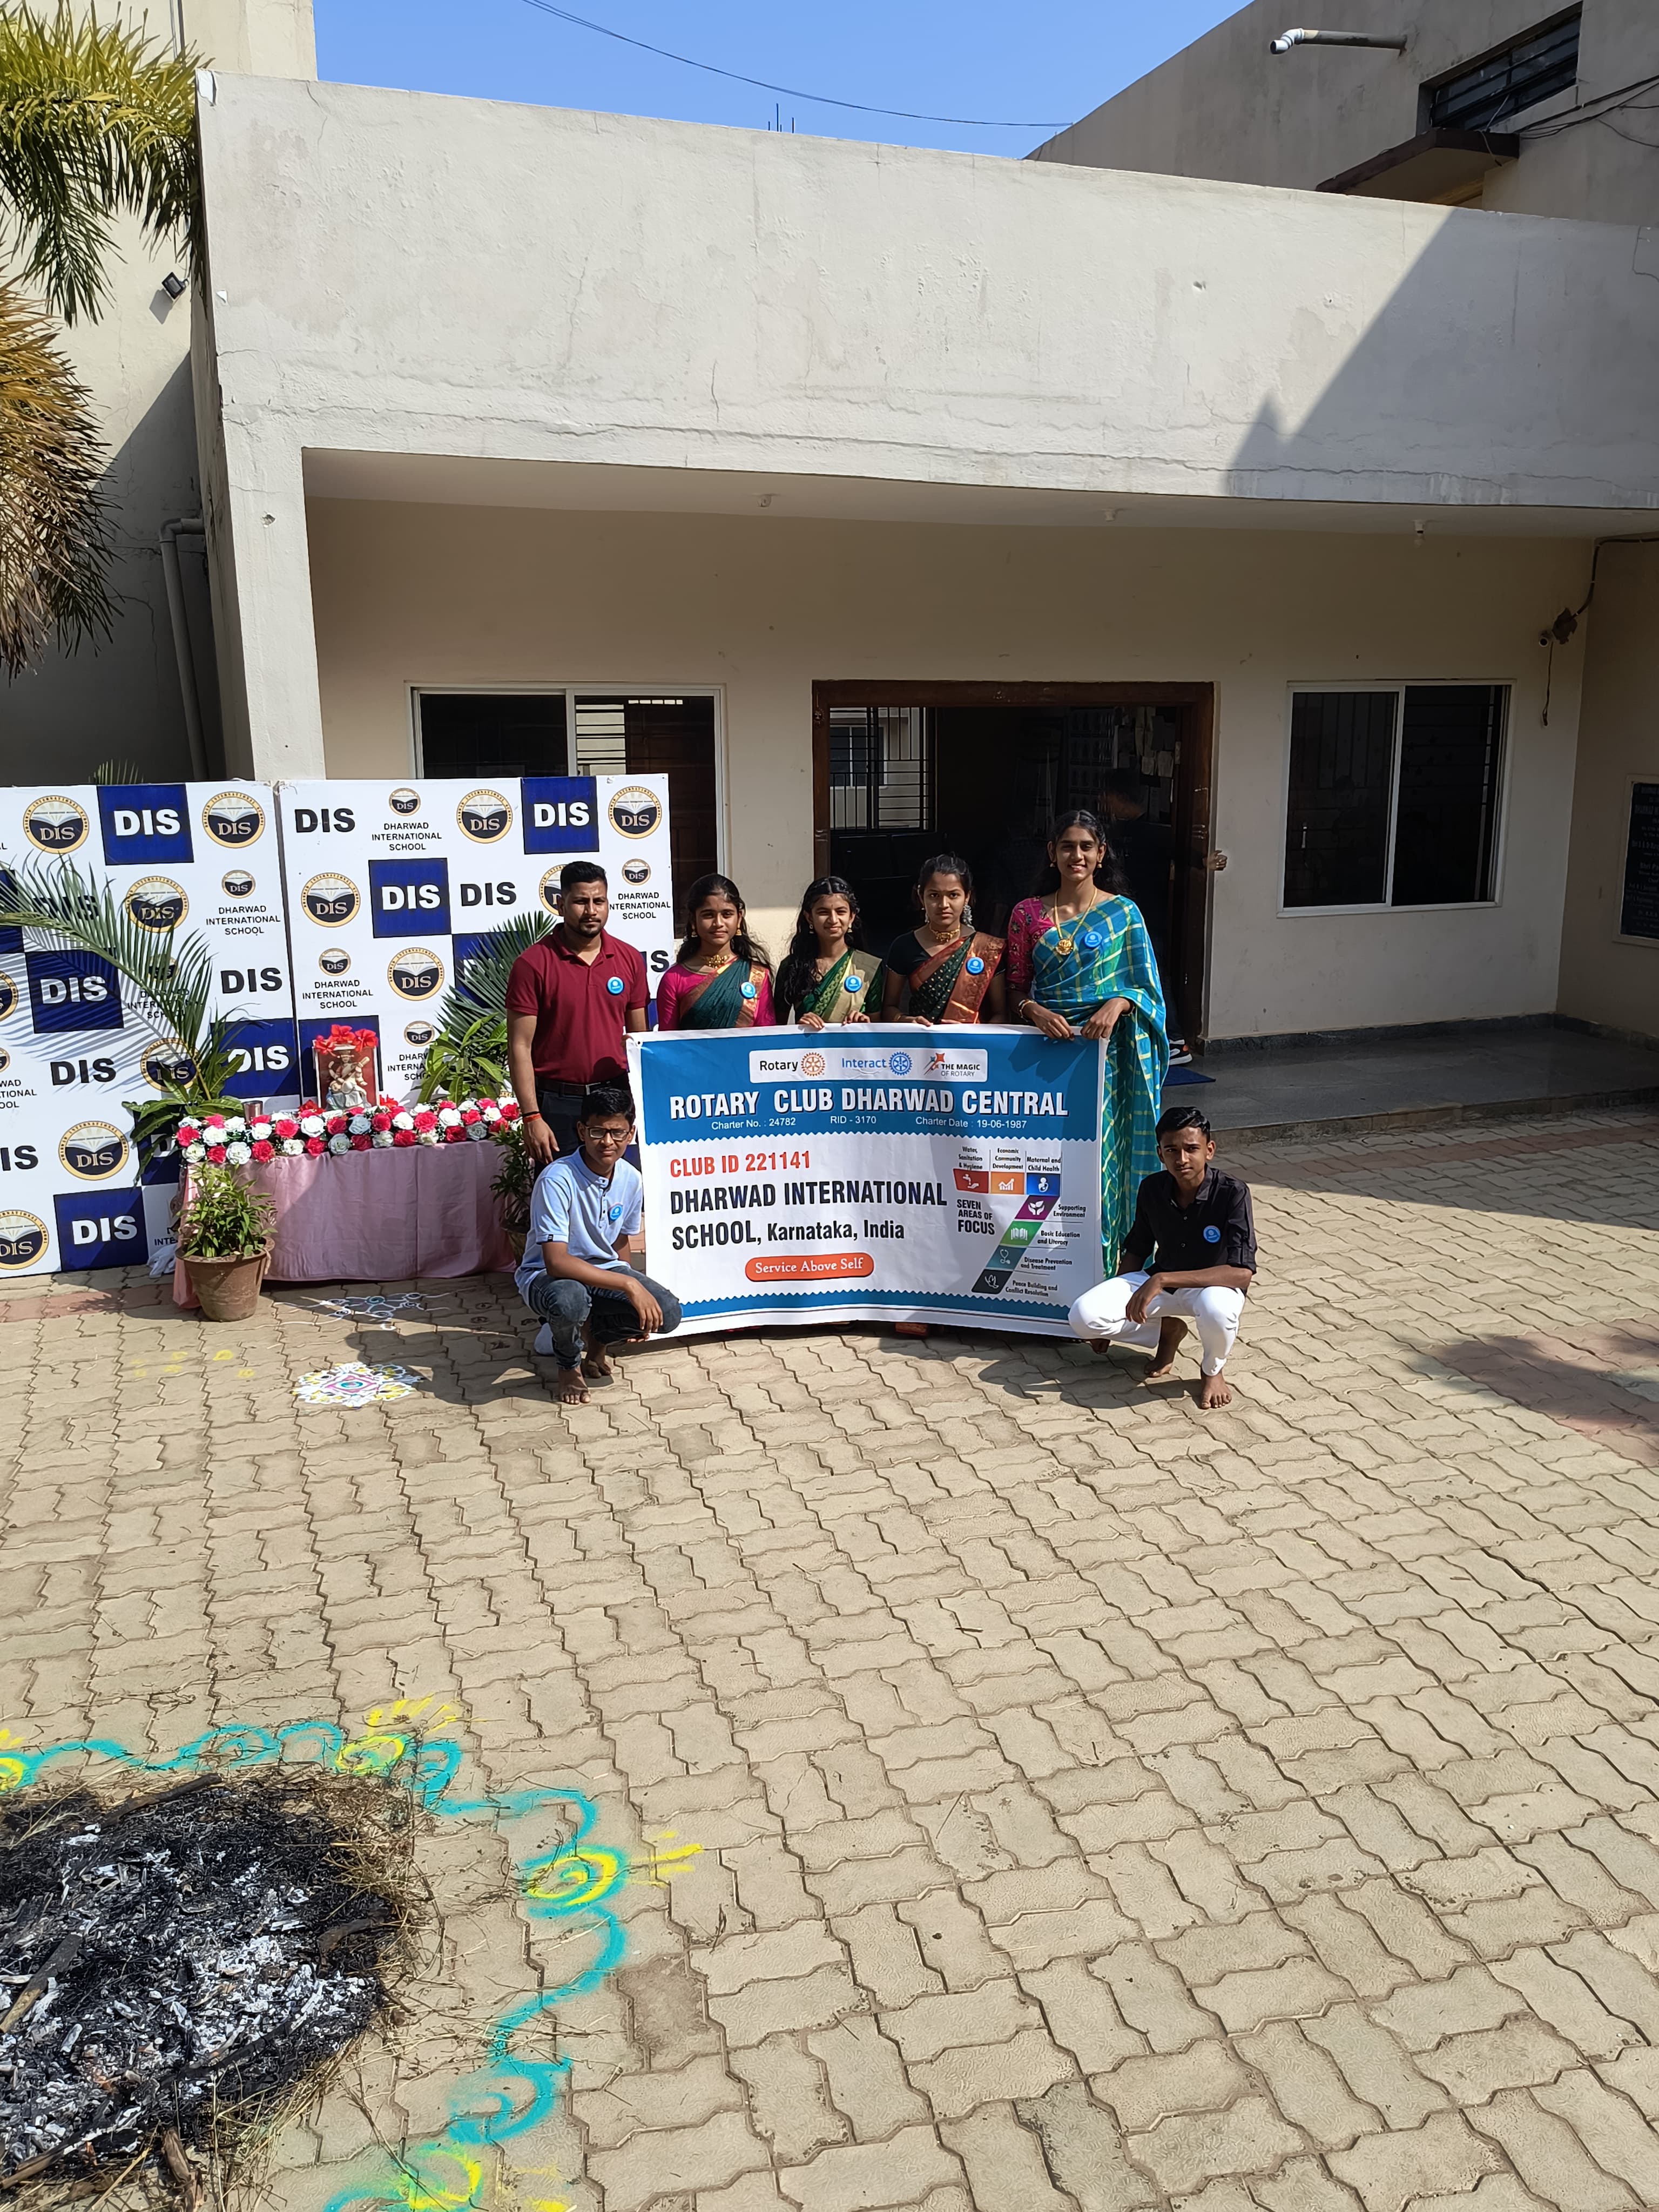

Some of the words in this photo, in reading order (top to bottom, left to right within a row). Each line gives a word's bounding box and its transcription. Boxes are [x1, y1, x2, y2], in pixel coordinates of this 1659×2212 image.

[294, 808, 355, 833] DIS
[534, 802, 590, 827] DIS
[621, 814, 650, 826] DIS
[113, 809, 180, 836] DIS
[218, 822, 251, 835] DIS
[384, 822, 429, 831] DHARWAD
[470, 818, 500, 831] DIS
[40, 827, 75, 840] DIS
[372, 832, 442, 841] INTERNATIONAL
[382, 884, 440, 910] DIS
[460, 882, 516, 906] DIS
[618, 892, 659, 900] DHARWAD
[219, 906, 266, 914] DHARWAD
[315, 902, 347, 915] DIS
[609, 901, 671, 910] NTERNATIONAL
[141, 907, 174, 920] DIS
[206, 915, 281, 925] INTERNATIONAL
[225, 926, 264, 935] SCHOOL
[220, 967, 282, 994] DIS
[314, 980, 360, 989] DHARWAD
[401, 976, 431, 989] DIS
[41, 976, 107, 1004] DIS
[302, 989, 373, 1000] INTERNATIONAL
[320, 1000, 358, 1009] SCHOOL
[388, 1063, 426, 1071] INTERNA
[760, 1060, 798, 1072] Rotary
[842, 1058, 886, 1068] Interact
[50, 1058, 116, 1085] DIS
[670, 1091, 759, 1120] ROTARY
[774, 1088, 833, 1113] CLUB
[842, 1088, 954, 1113] DHARWAD
[962, 1090, 1069, 1116] CENTRAL
[711, 1121, 744, 1130] Charter
[746, 1120, 761, 1128] No.
[769, 1117, 795, 1127] 24782
[831, 1116, 847, 1124] RID
[855, 1116, 876, 1124] 3170
[916, 1117, 946, 1125] Charter
[949, 1118, 968, 1128] Date
[977, 1120, 1027, 1128] 19-06-1987
[0, 1145, 38, 1171] IS
[76, 1152, 114, 1168] DIS
[671, 1157, 715, 1177] CLUB
[722, 1155, 738, 1173] ID
[746, 1151, 810, 1171] 221141
[671, 1184, 776, 1214] DHARWAD
[785, 1181, 947, 1206] INTERNATIONAL
[957, 1199, 981, 1210] SEVEN
[958, 1210, 982, 1218] AREAS
[72, 1216, 137, 1245] DIS
[958, 1219, 995, 1235] FOCUS
[672, 1220, 761, 1250] SCHOOL,
[768, 1221, 858, 1241] Karnataka,
[864, 1220, 904, 1239] India
[756, 1262, 797, 1274] Service
[800, 1260, 837, 1272] Above
[840, 1258, 863, 1270] Self
[1028, 1282, 1047, 1290] Building
